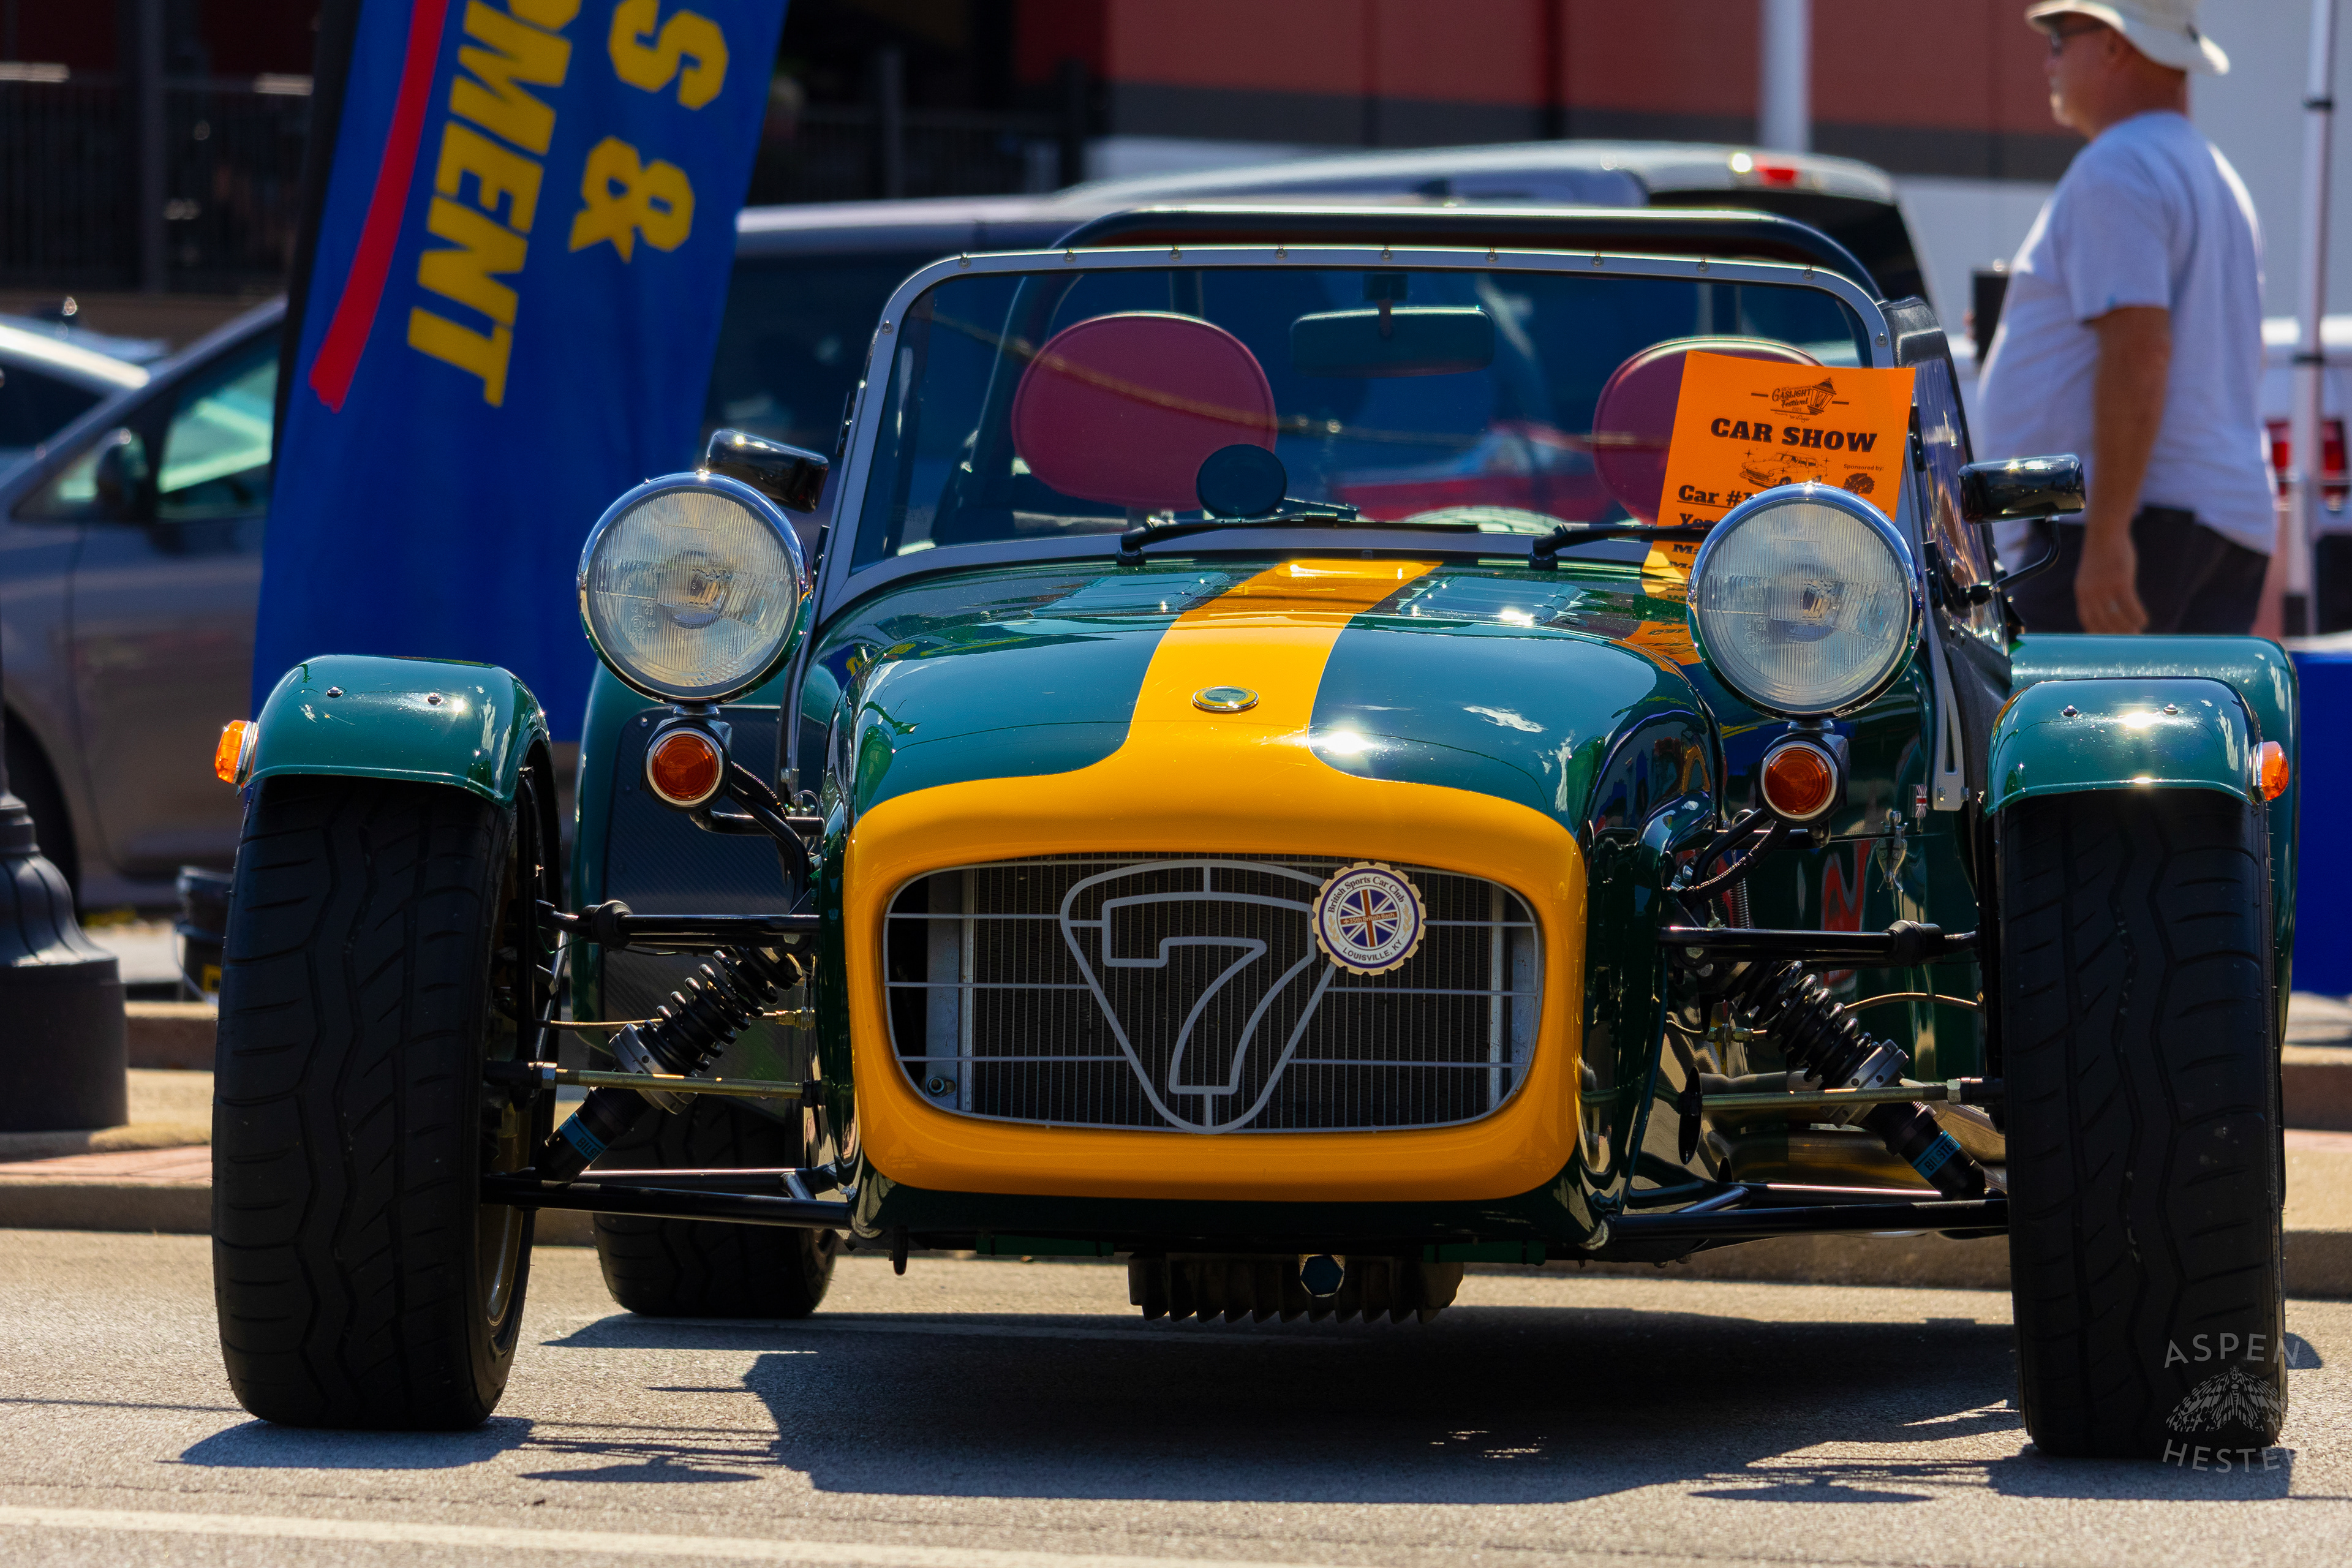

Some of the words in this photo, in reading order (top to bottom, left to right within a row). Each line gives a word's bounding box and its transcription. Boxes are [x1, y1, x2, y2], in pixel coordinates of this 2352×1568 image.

[568, 136, 695, 264] &
[1781, 398, 1809, 409] Festival
[1710, 417, 1773, 443] CAR
[1781, 426, 1877, 453] SHOW
[1678, 484, 1720, 504] Car
[1327, 887, 1346, 913] British
[1344, 876, 1371, 889] Sports
[1373, 876, 1389, 888] Car
[1389, 884, 1404, 903] Club
[1343, 947, 1393, 961] LOUISVILLE,
[1392, 939, 1403, 951] KY
[1102, 891, 1316, 1095] 7
[575, 1136, 601, 1159] BILST
[1923, 1137, 1958, 1172] BILSTEIN
